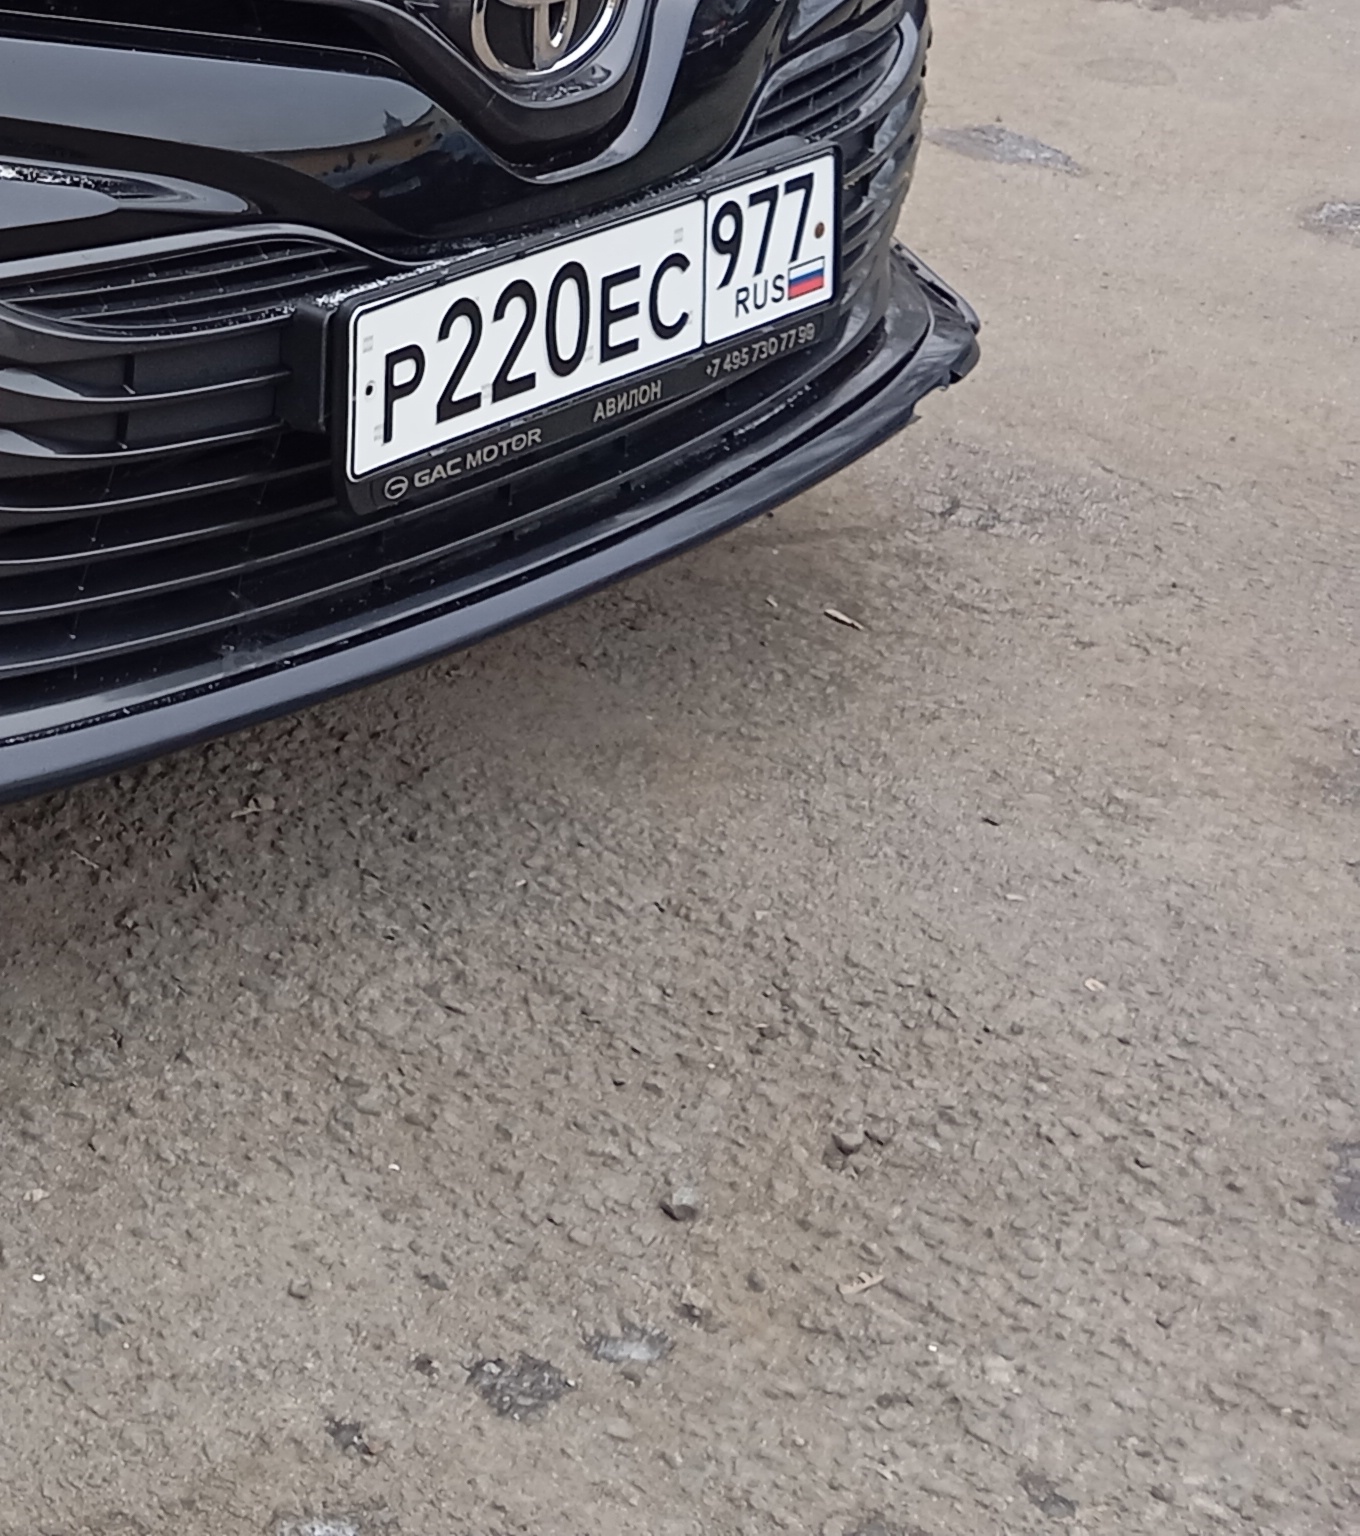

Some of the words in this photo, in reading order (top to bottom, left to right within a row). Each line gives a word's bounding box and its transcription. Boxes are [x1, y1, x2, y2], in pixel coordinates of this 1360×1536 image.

[710, 172, 816, 291] 977
[734, 272, 786, 319] RUS
[722, 347, 749, 373] 495
[751, 336, 778, 363] 730
[592, 379, 662, 423] АВИЛОН
[413, 455, 462, 490] GAC
[464, 427, 543, 471] MOTOR
